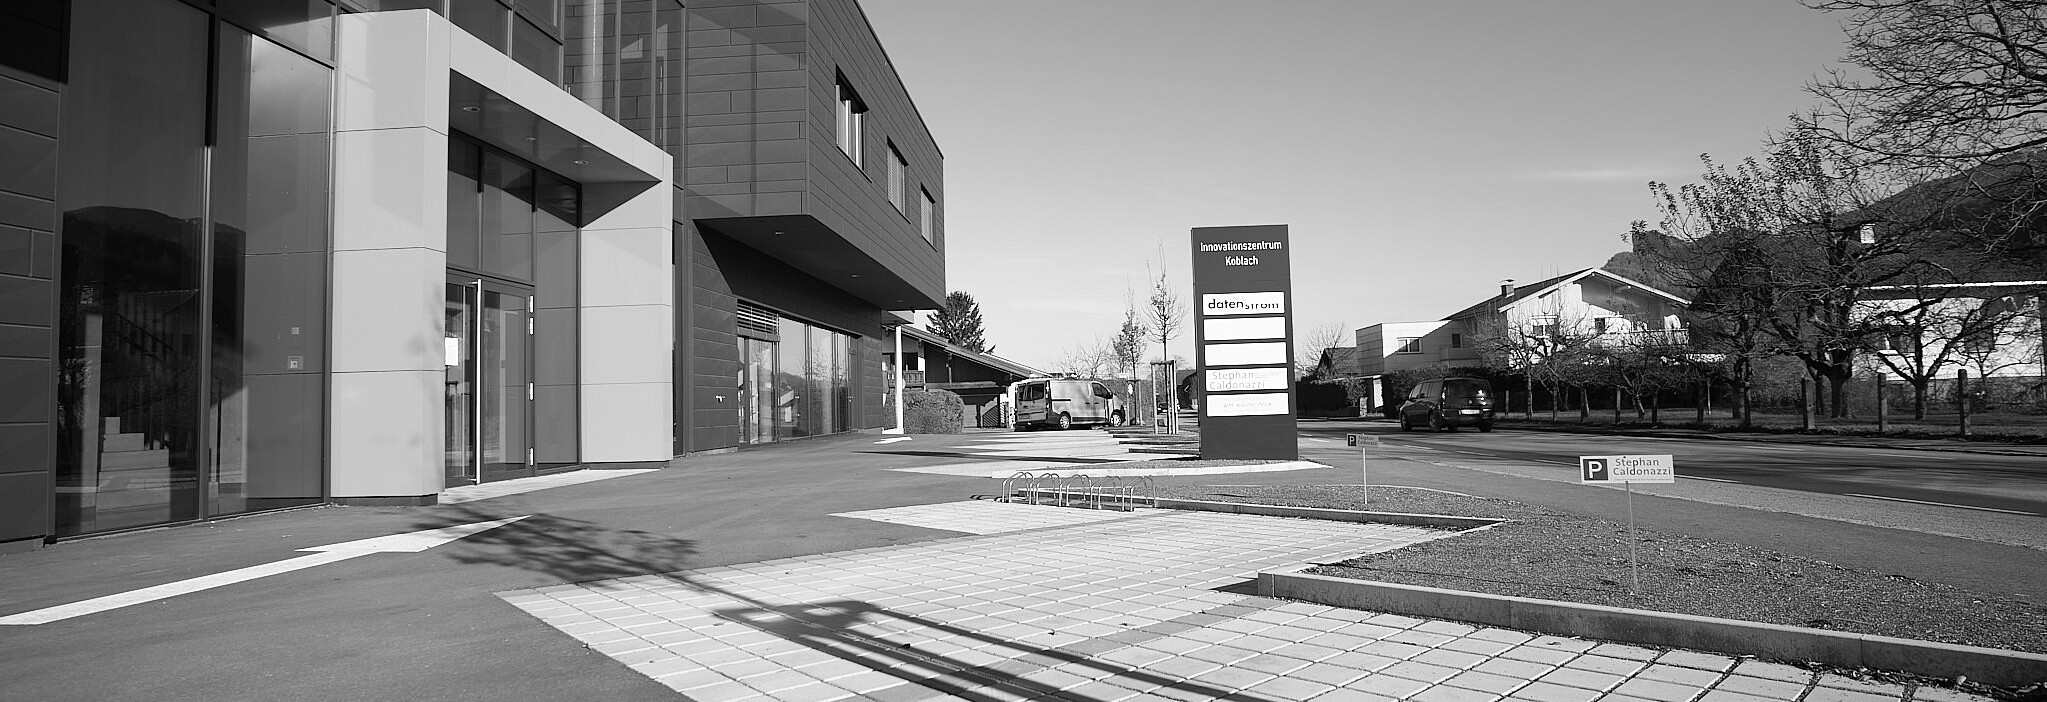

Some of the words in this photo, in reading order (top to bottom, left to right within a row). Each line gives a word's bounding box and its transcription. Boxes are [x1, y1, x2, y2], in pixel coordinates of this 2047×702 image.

[1200, 241, 1282, 252] Innovationszentrum
[1225, 256, 1258, 266] Koblach
[1212, 371, 1254, 381] Stephan
[1209, 380, 1265, 389] Caldonazzi
[1615, 458, 1659, 468] Stephan
[1588, 460, 1603, 479] P
[1613, 467, 1671, 476] Caldonazzi
